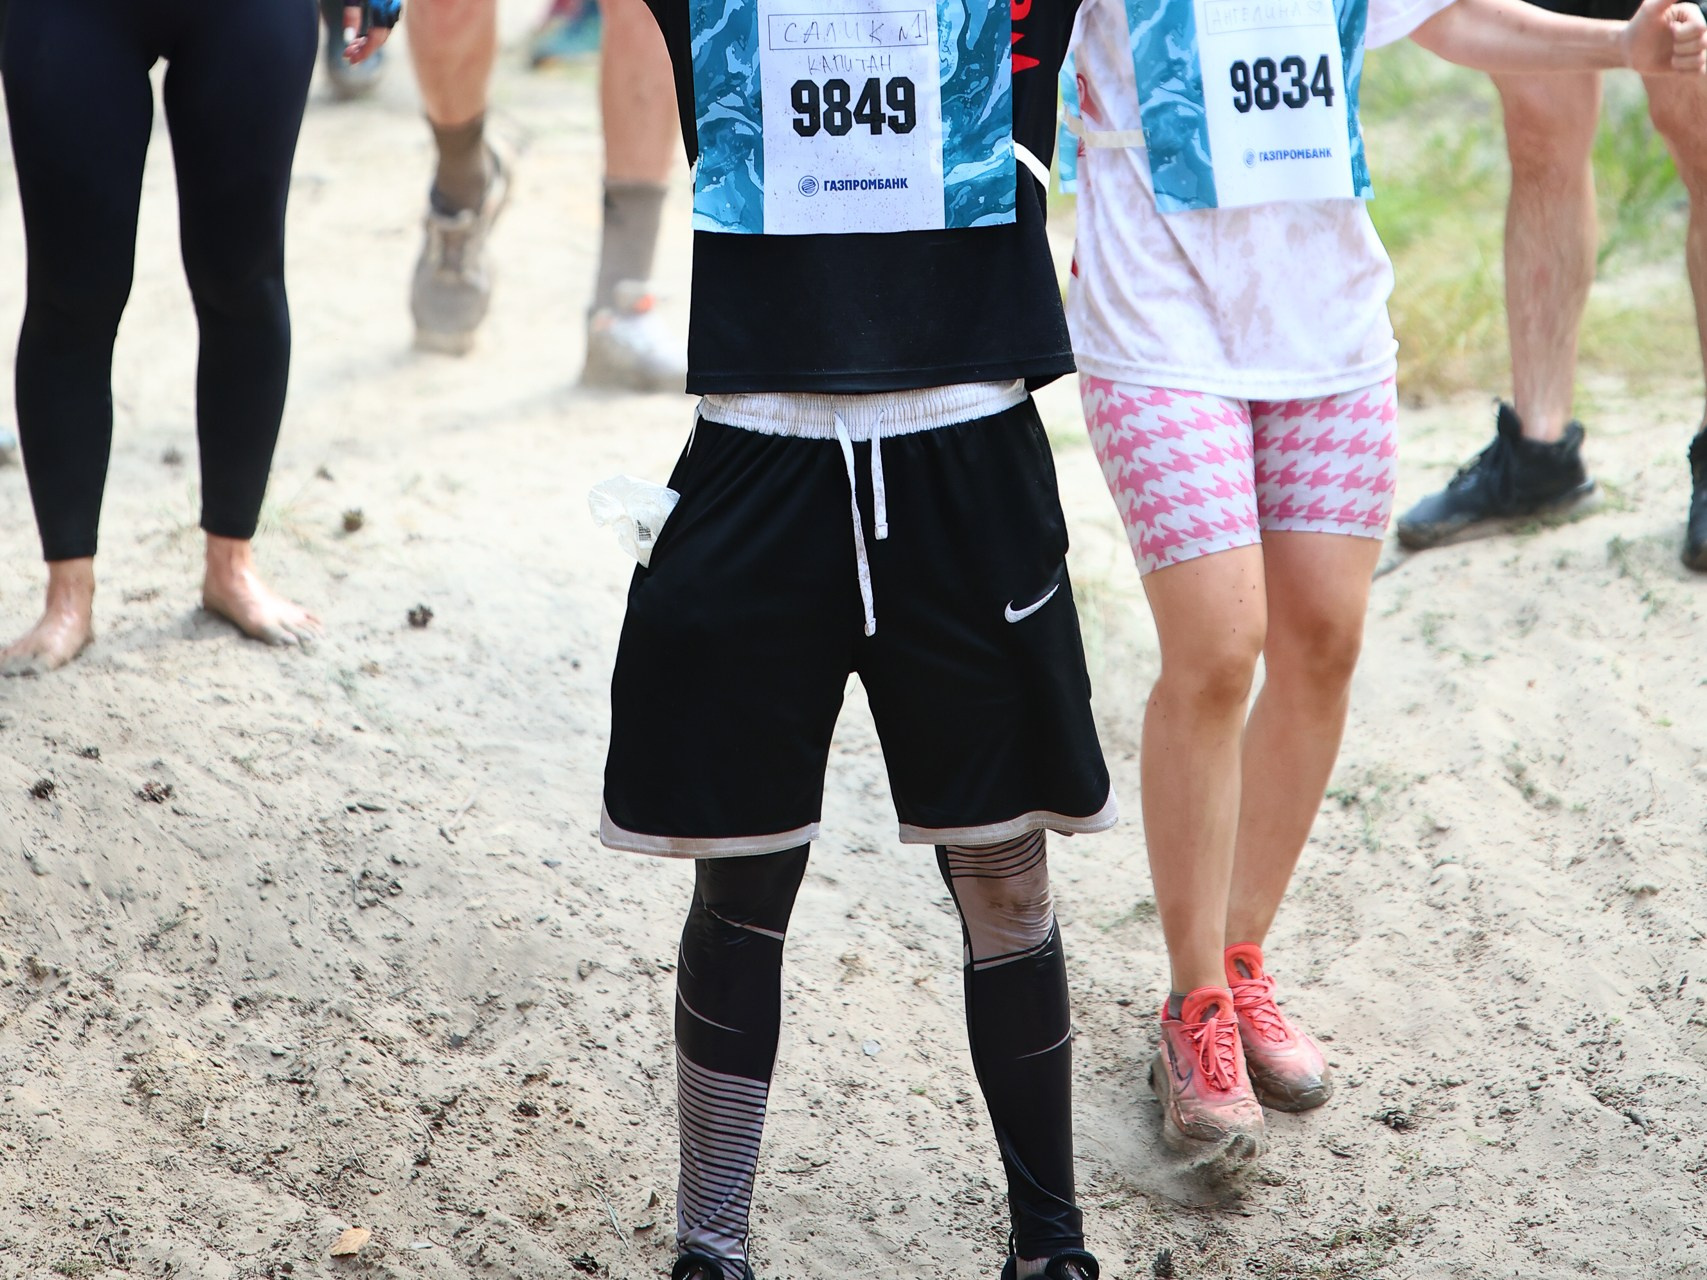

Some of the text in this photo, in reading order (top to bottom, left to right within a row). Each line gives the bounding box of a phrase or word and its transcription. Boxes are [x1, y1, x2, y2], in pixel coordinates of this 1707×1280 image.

[807, 54, 892, 75] КАПИТАН
[1230, 53, 1335, 113] 9834
[790, 76, 917, 137] 9849
[1258, 147, 1333, 162] ГАЗПРОМБАНК
[823, 177, 909, 192] ГАЗПРОМБАНК
